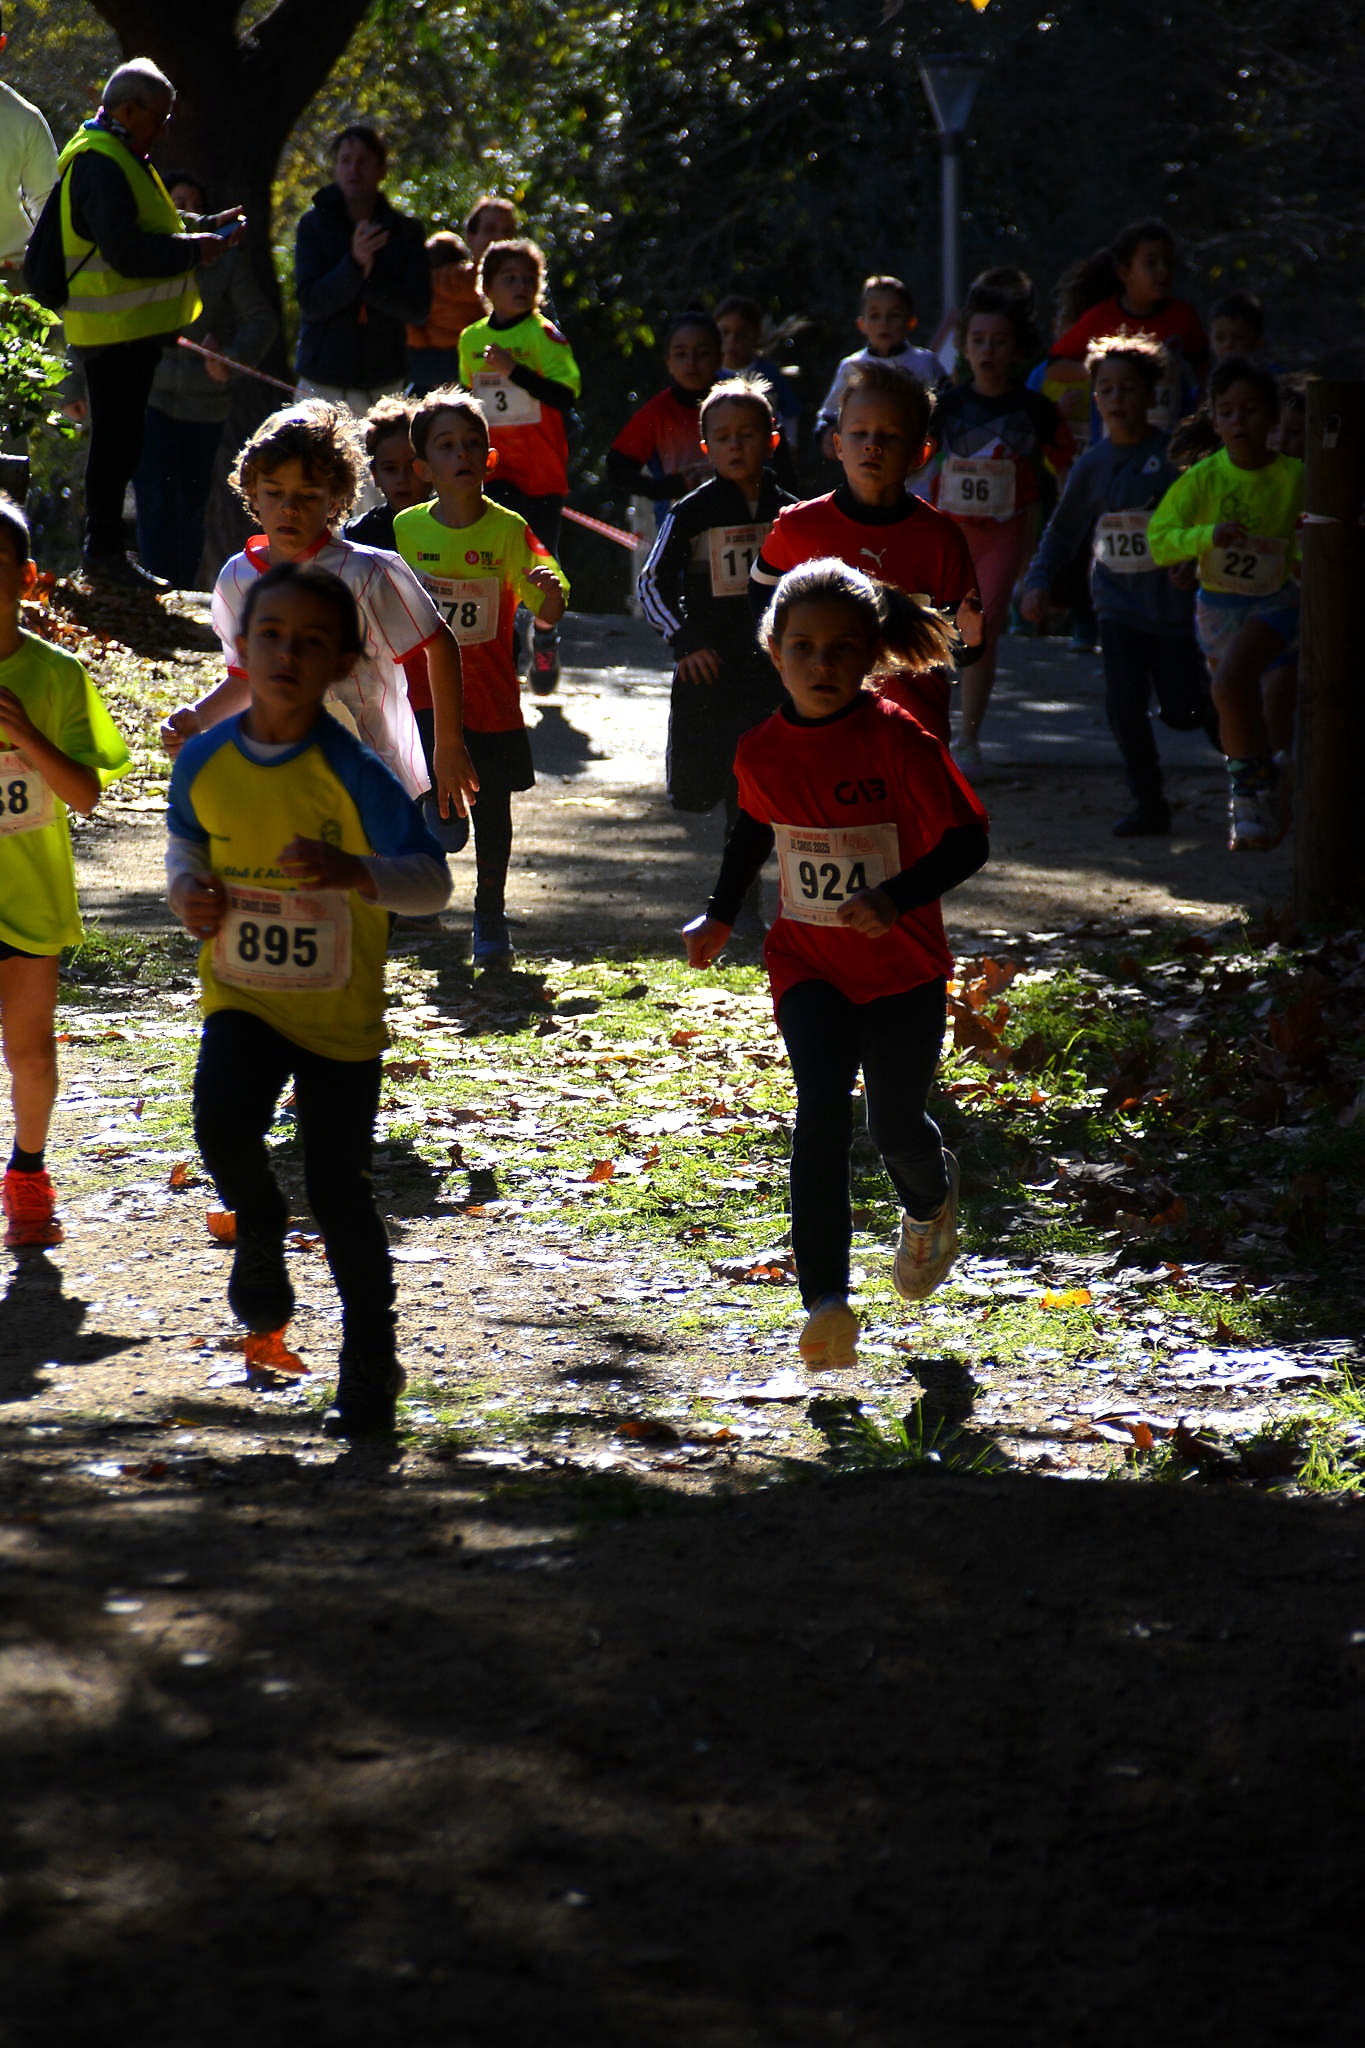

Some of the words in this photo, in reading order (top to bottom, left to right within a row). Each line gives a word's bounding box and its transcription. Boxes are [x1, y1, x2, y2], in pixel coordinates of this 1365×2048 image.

[495, 390, 508, 412] 3
[962, 477, 989, 502] 96
[1107, 533, 1146, 557] 126
[723, 548, 752, 577] 11
[1224, 552, 1256, 579] 22
[438, 600, 478, 627] 78
[0, 780, 28, 816] 8
[799, 861, 867, 901] 924
[238, 921, 318, 968] 895
